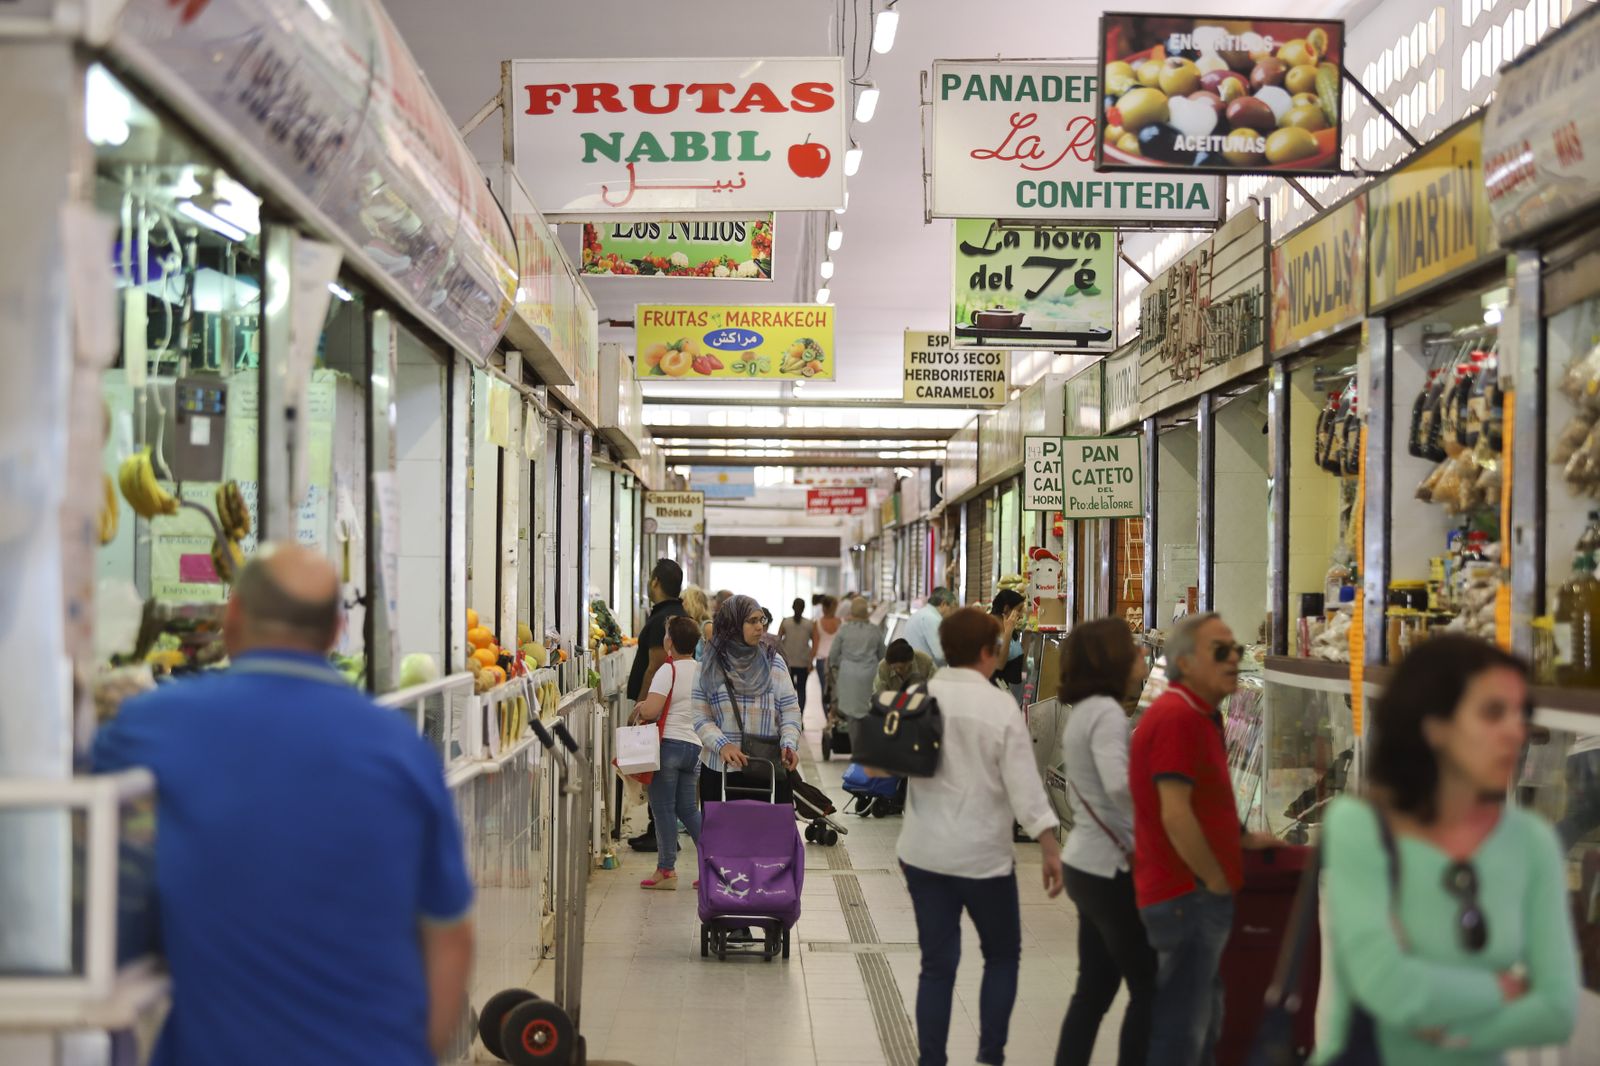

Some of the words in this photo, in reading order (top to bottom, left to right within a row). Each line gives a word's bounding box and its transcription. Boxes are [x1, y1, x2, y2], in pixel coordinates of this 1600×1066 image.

[524, 82, 835, 115] FRUTAS
[580, 130, 771, 163] NABIL
[970, 111, 1045, 161] La
[1020, 115, 1097, 172] R
[1174, 134, 1266, 154] ACEITUNAS
[601, 161, 747, 207] نبيل
[1016, 180, 1210, 210] CONFITERIA
[959, 221, 1020, 256] La
[969, 264, 1014, 291] del
[1022, 256, 1097, 300] Té
[643, 310, 708, 327] FRUTAS
[726, 311, 827, 328] MARRAKECH
[712, 331, 758, 347] مراكش
[911, 352, 959, 364] FRUTOS
[963, 353, 1001, 365] SECOS
[905, 369, 1006, 382] HERBORISTERIA
[916, 386, 995, 399] CARAMELOS
[1043, 442, 1062, 457] P
[1082, 445, 1119, 462] PAN
[1072, 467, 1134, 485] CATETO
